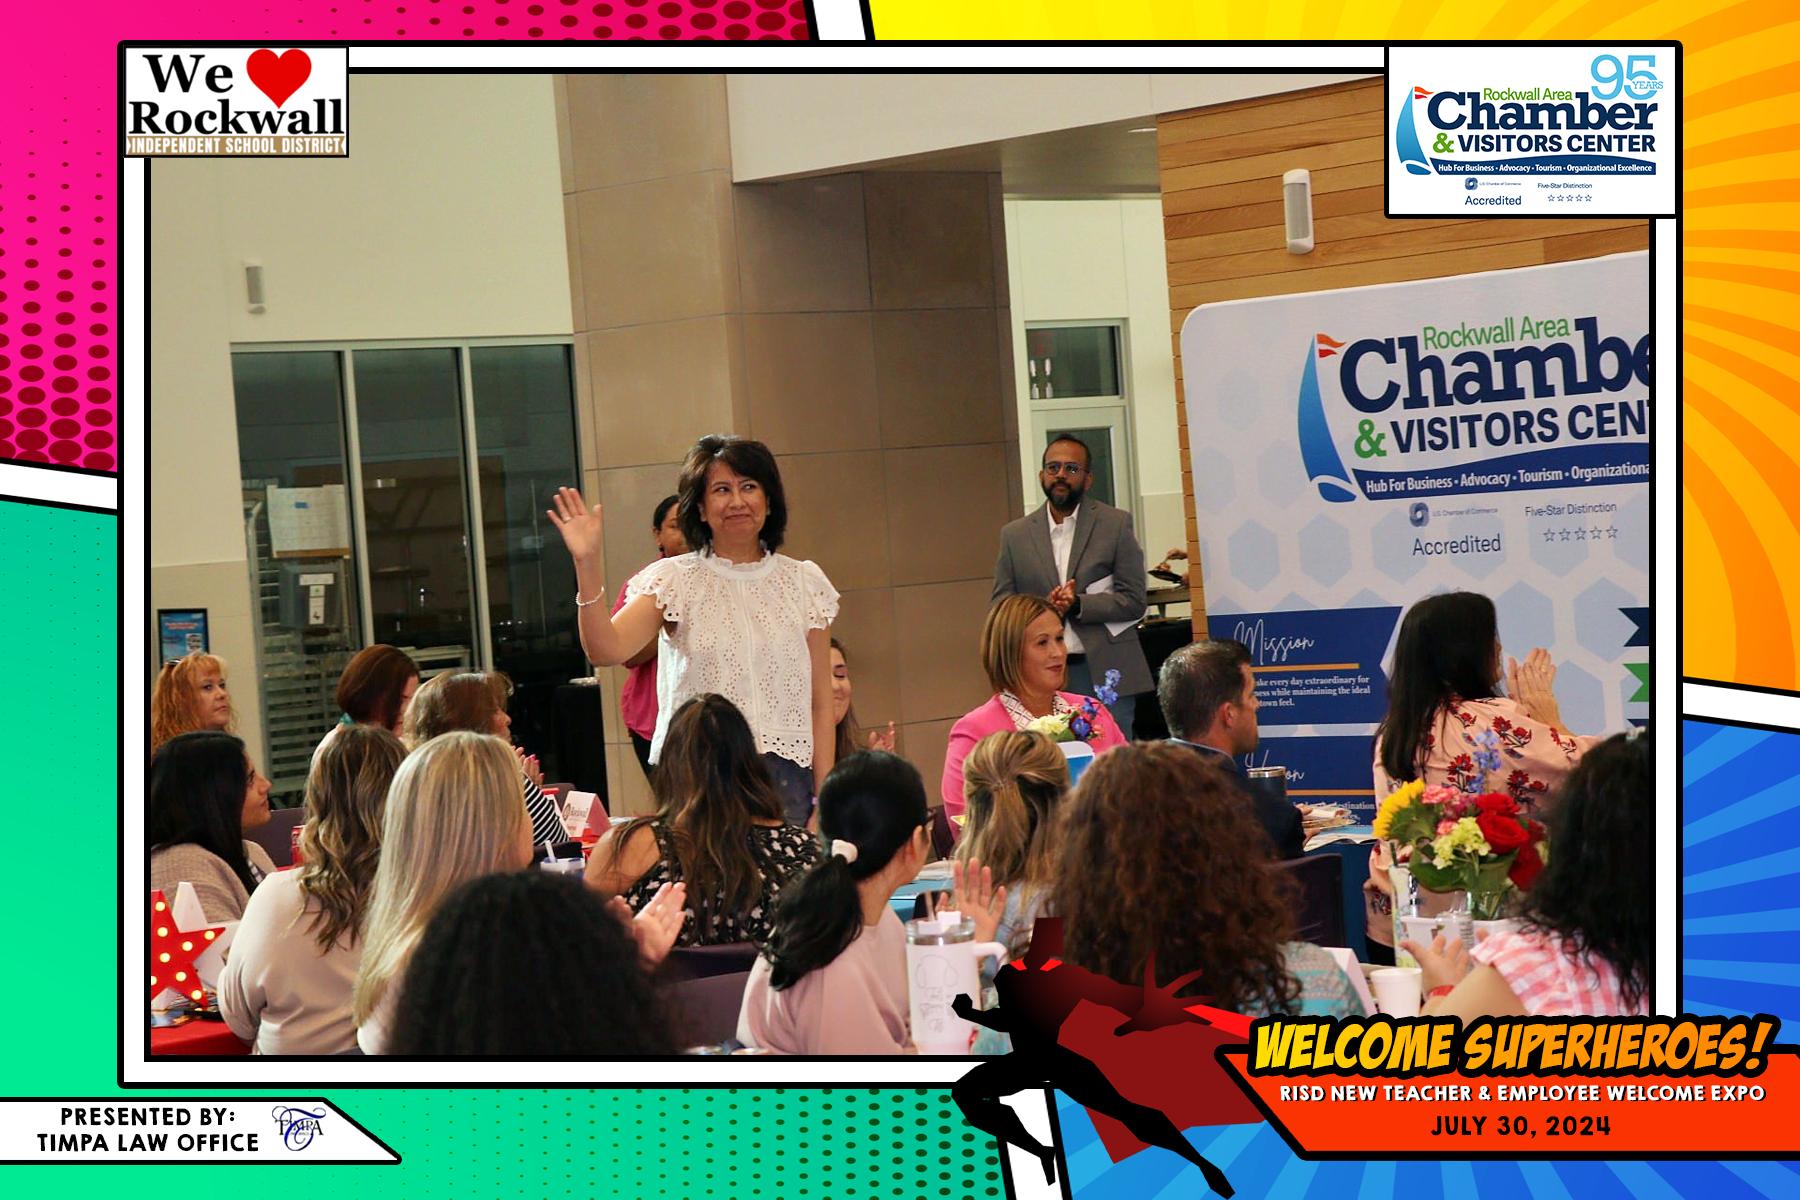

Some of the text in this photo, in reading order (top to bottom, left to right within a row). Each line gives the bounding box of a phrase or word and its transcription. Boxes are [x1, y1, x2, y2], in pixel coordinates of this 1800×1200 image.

[1422, 316, 1570, 350] Rockwall Area
[1353, 400, 1650, 459] & VISITORS CEN
[1366, 479, 1388, 493] Hub
[1389, 478, 1406, 492] For
[1407, 476, 1453, 490] Business
[1460, 473, 1511, 488] Advocacy
[1517, 467, 1563, 483] Tourism
[1525, 502, 1617, 517] Five-Star Distinction
[1412, 533, 1501, 556] Accredited
[1233, 618, 1315, 666] Mission
[1255, 674, 1370, 688] ake every day extraordinary for
[1271, 688, 1291, 697] while
[1292, 687, 1337, 696] maintaining
[1338, 686, 1351, 695] the
[1352, 686, 1371, 694] ideal
